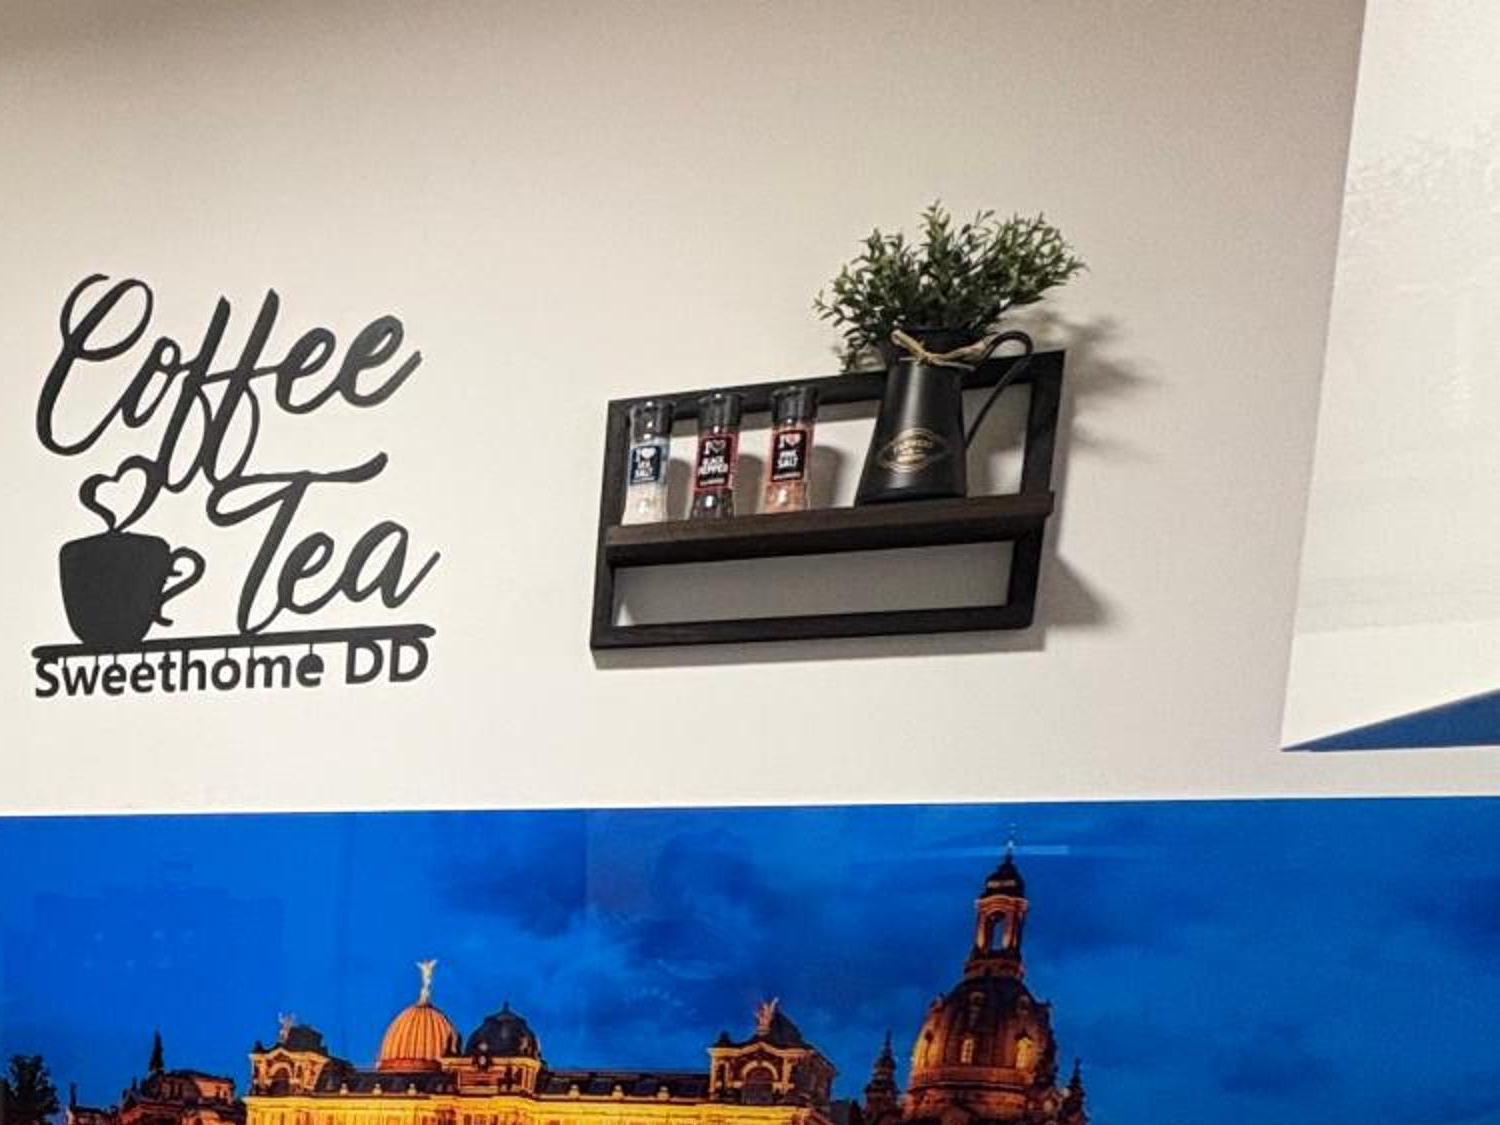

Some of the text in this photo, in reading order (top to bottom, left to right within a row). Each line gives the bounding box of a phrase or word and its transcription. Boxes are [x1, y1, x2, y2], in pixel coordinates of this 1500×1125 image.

[36, 273, 422, 493] Coffee
[206, 452, 441, 634] Tea
[34, 637, 429, 698] Sweethome DD
